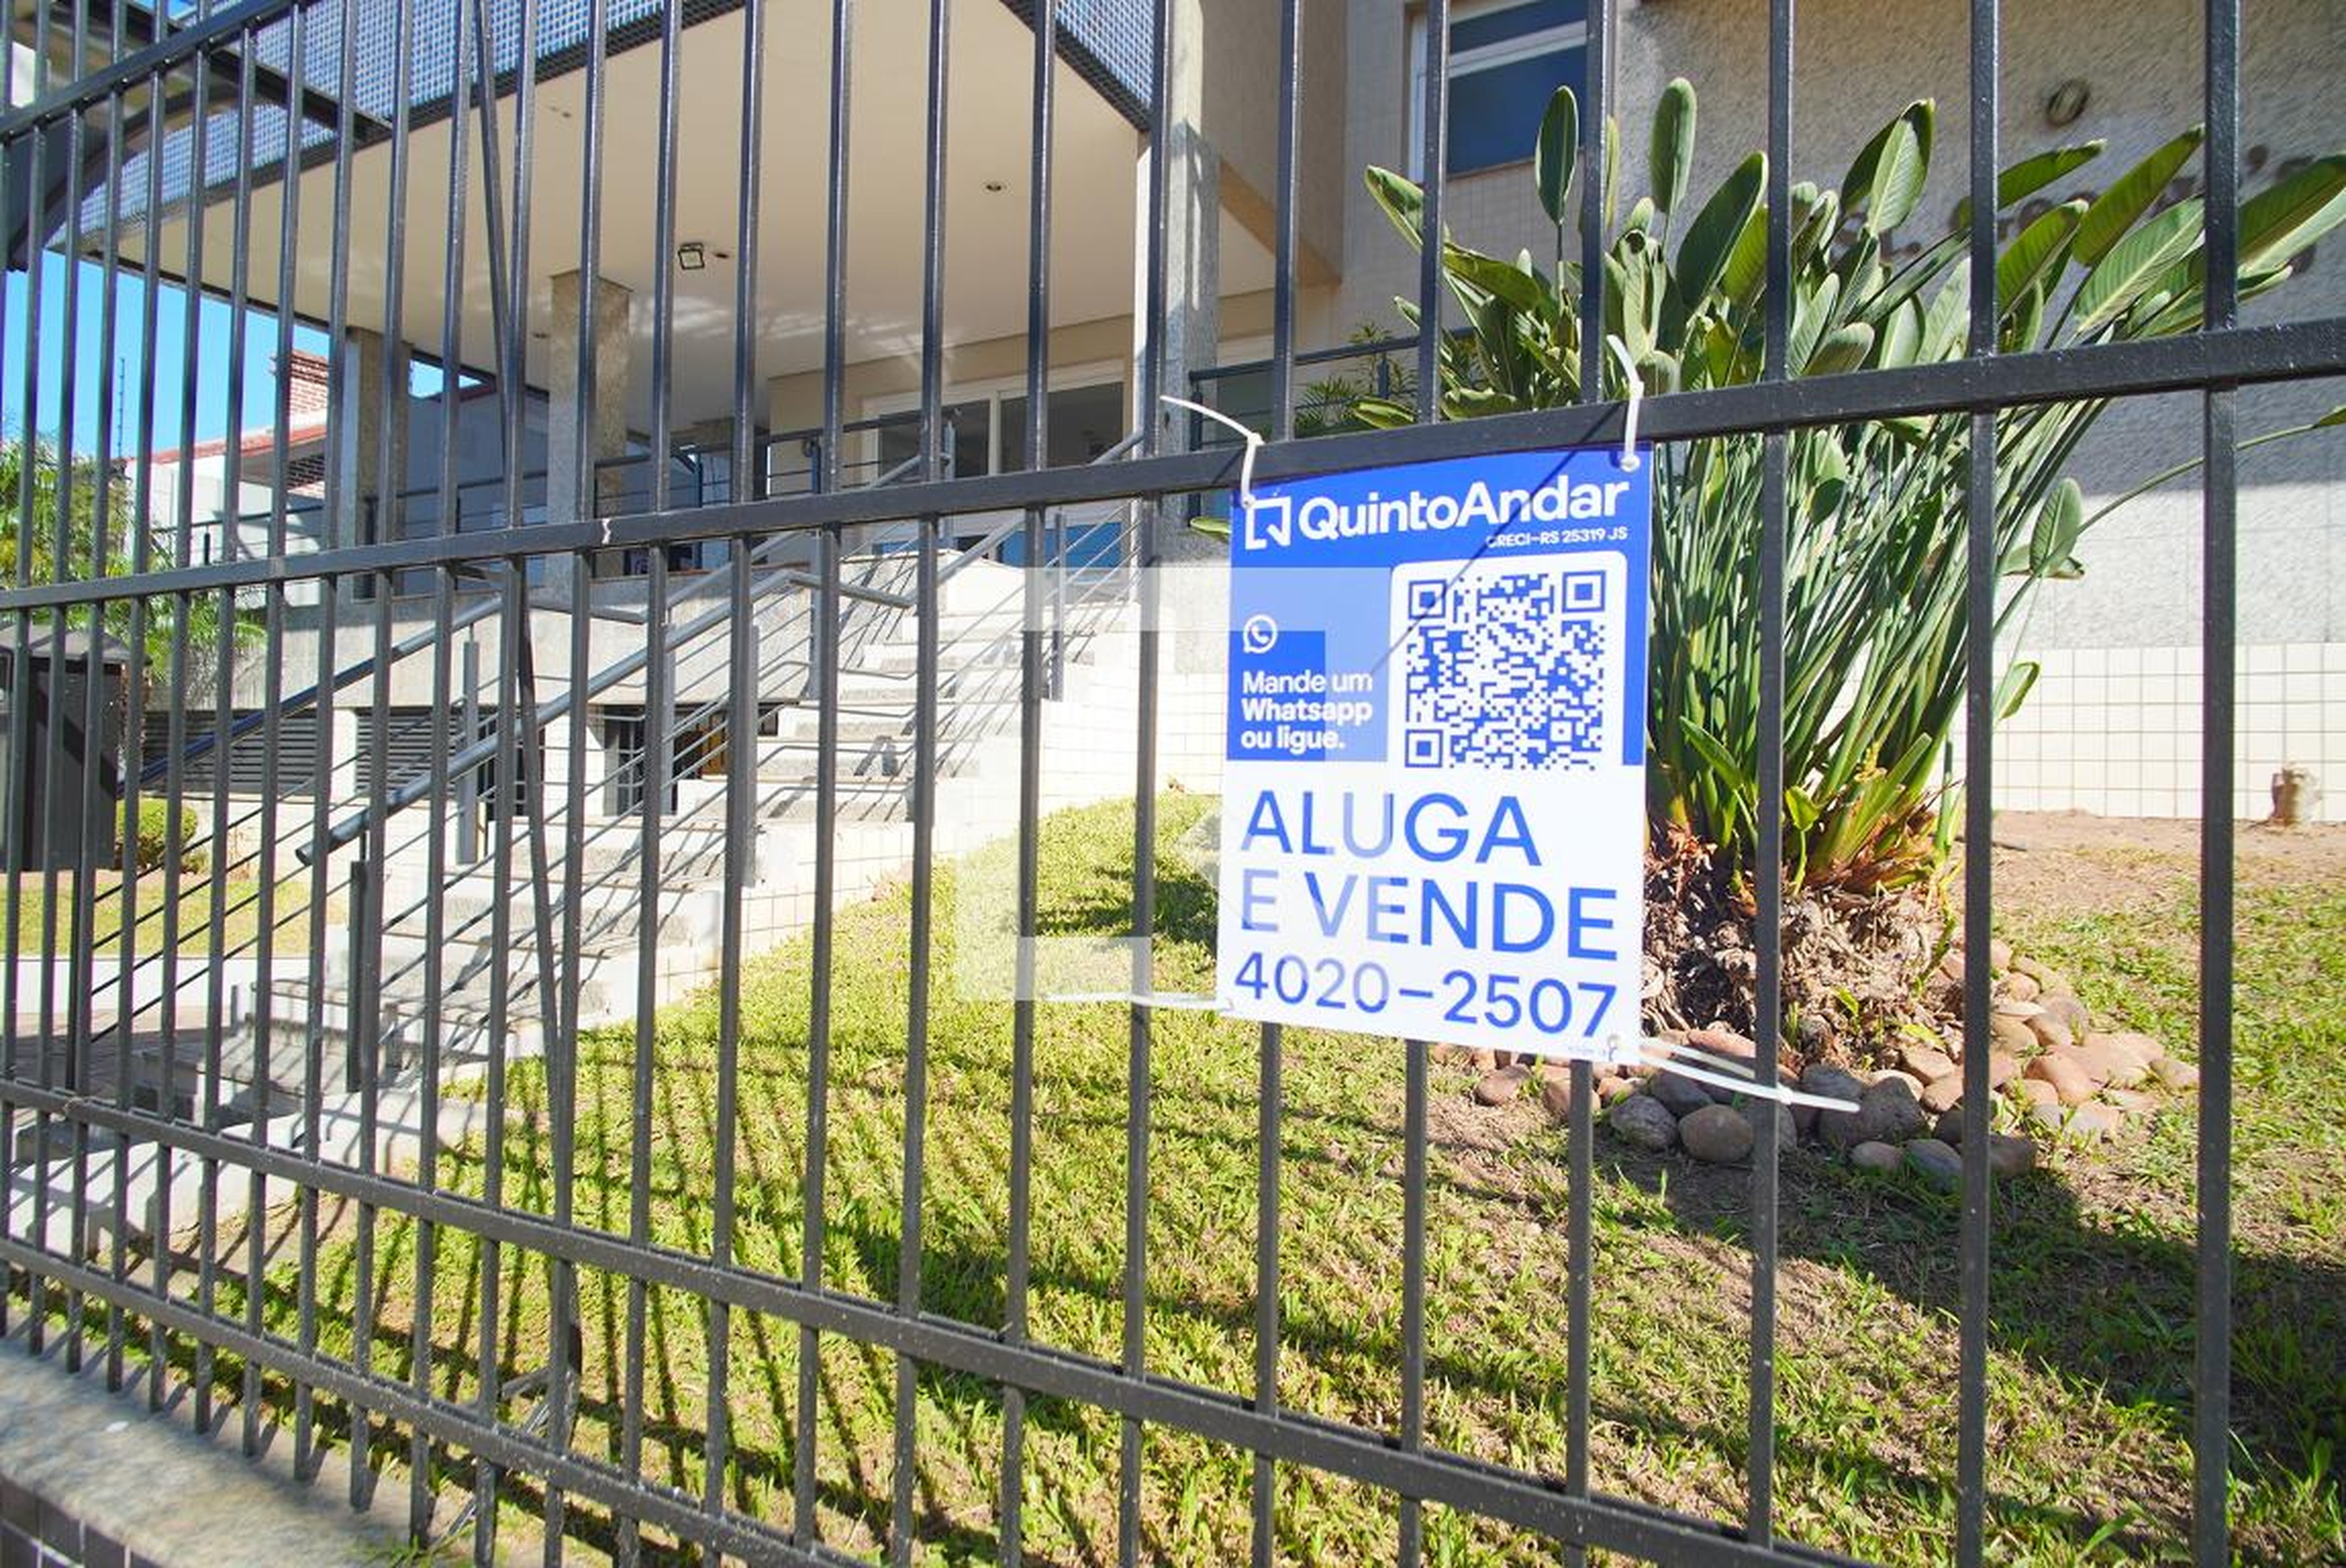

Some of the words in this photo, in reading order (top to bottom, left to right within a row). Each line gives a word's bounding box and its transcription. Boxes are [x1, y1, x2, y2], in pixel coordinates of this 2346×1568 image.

[1298, 474, 1631, 540] QuintoAndar
[1486, 530, 1560, 548] CRECI-RS
[1562, 528, 1606, 543] 25319
[1607, 526, 1628, 540] JS
[1242, 670, 1327, 694] Mande
[1331, 673, 1373, 693] um
[1241, 698, 1374, 726] Whatsapp
[1241, 731, 1272, 749] ou
[1277, 725, 1346, 755] ligue.
[1240, 789, 1543, 867] ALUGA
[1241, 868, 1279, 933] E
[1303, 870, 1619, 962] VENDE
[1234, 950, 1618, 1038] 4020-2507
